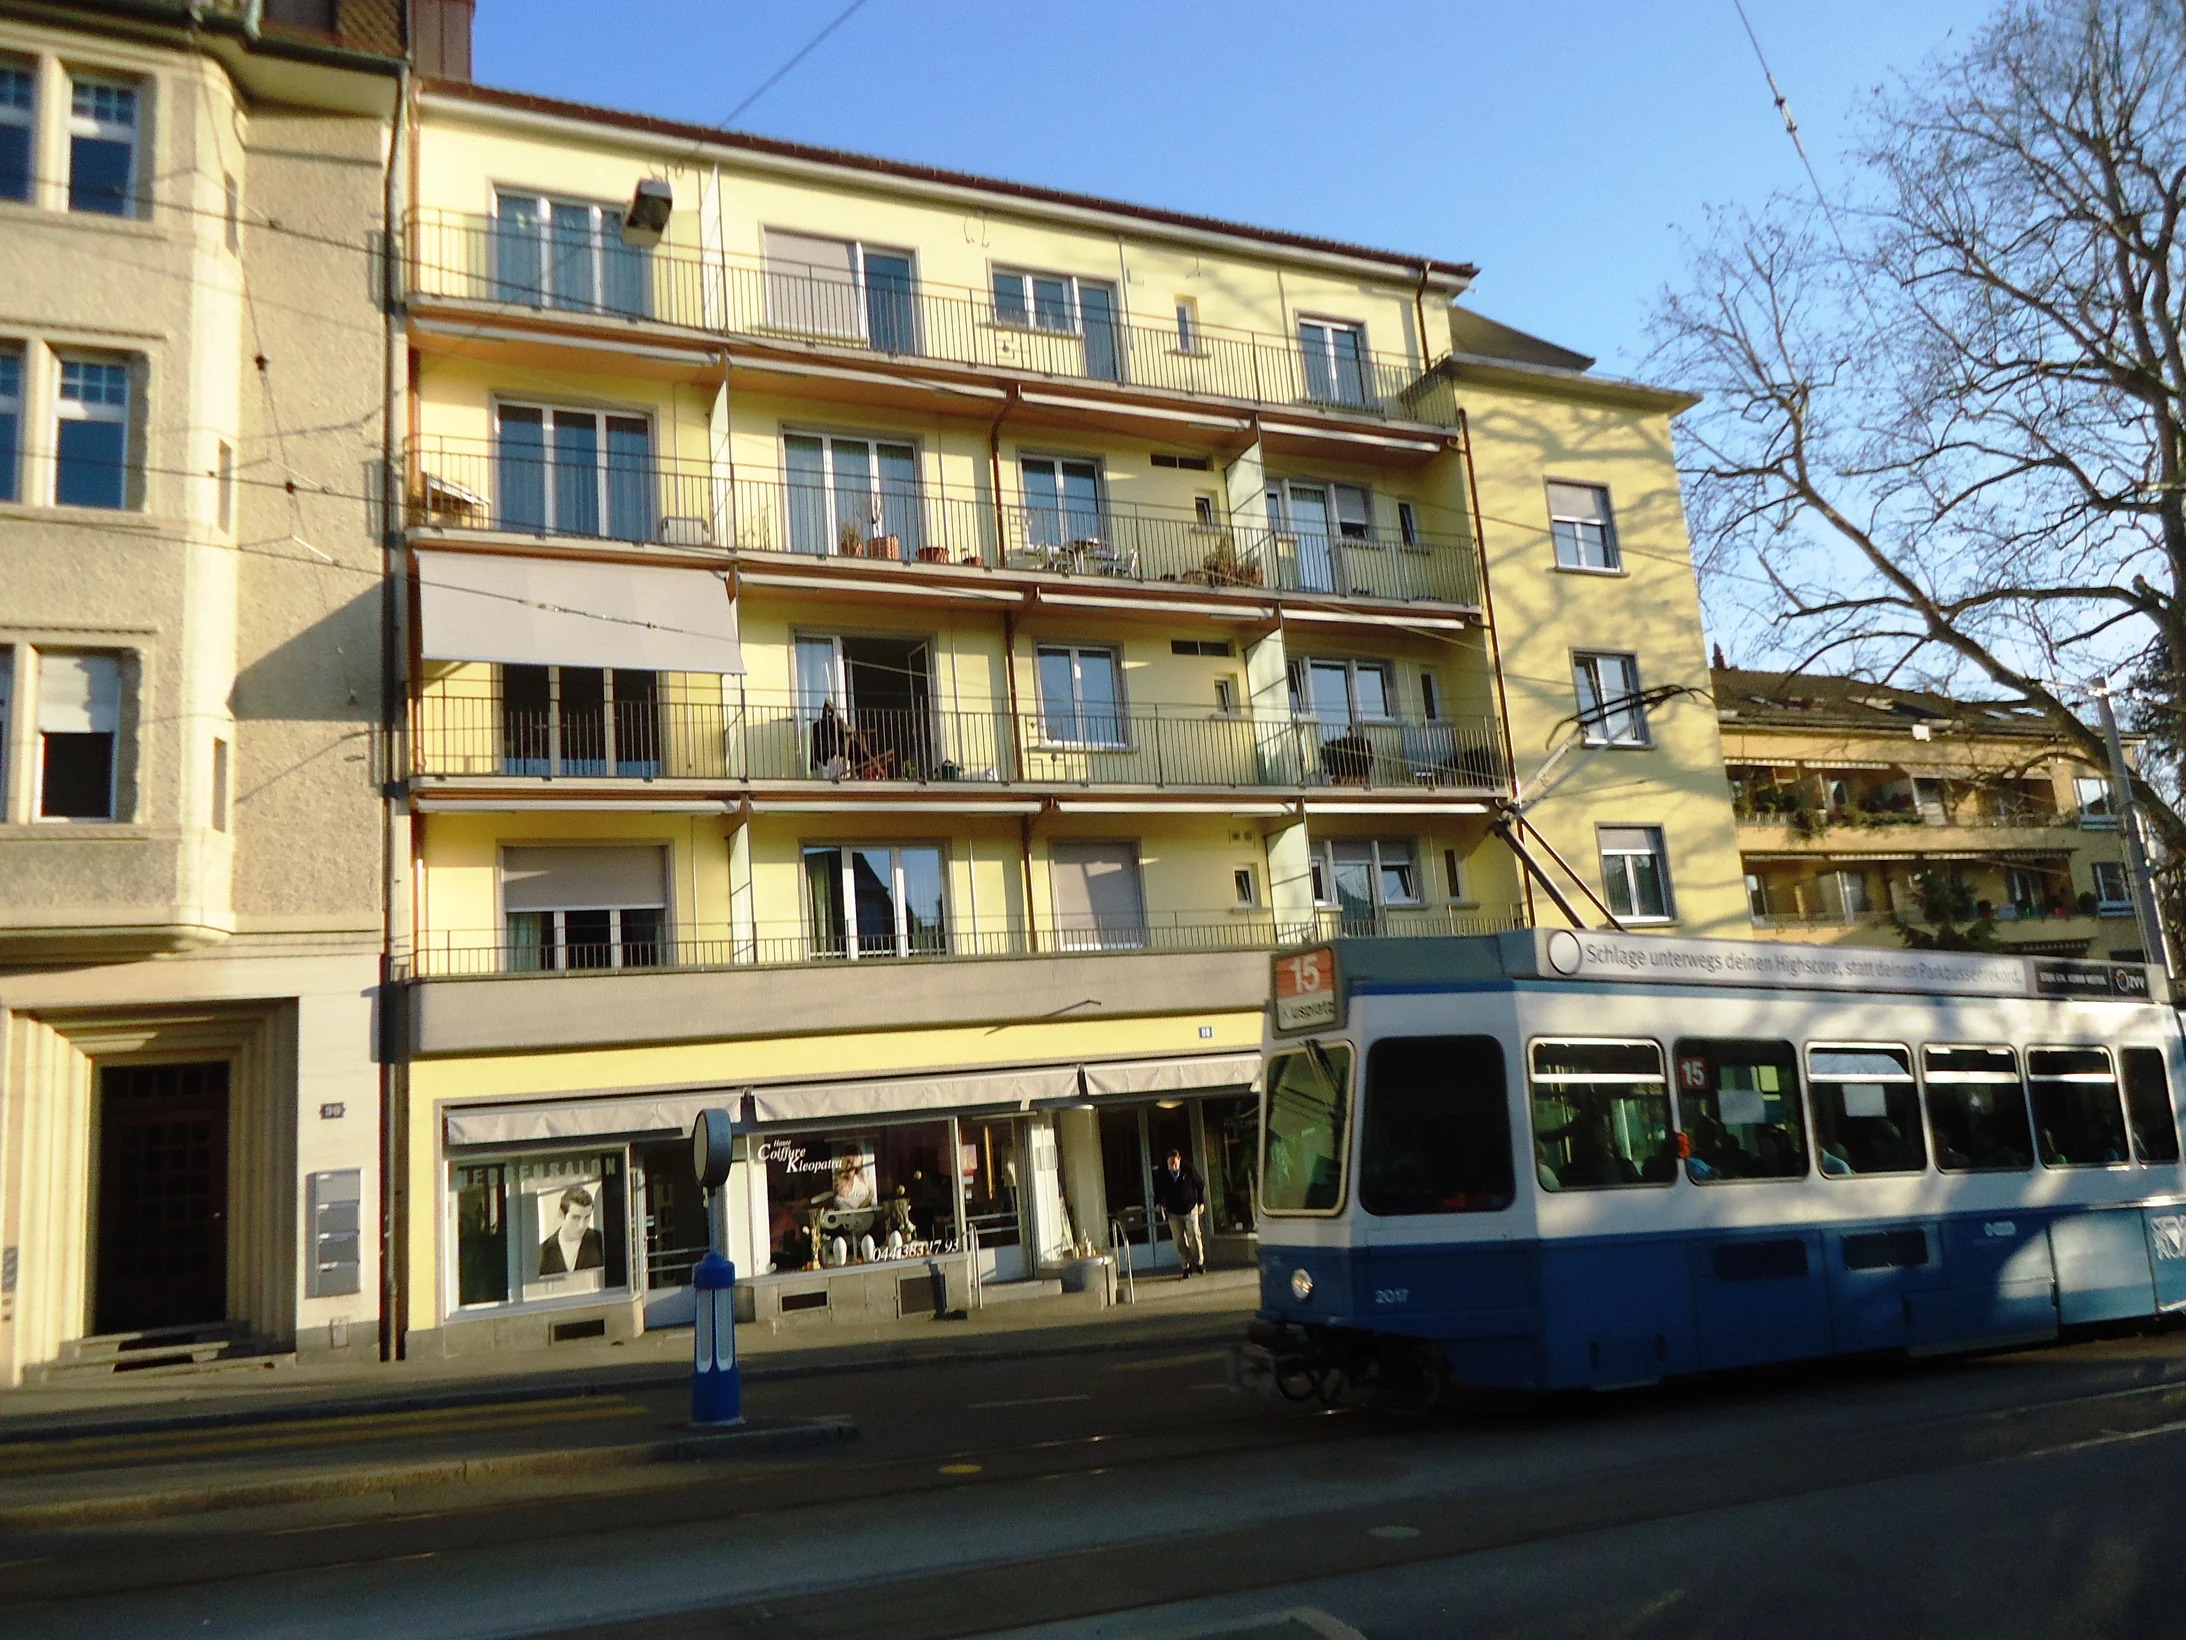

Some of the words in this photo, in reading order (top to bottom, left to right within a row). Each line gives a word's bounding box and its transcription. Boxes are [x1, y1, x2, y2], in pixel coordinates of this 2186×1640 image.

[1585, 943, 1646, 969] Schlage
[1650, 949, 1721, 973] unterwegs
[1725, 951, 1773, 972] deinen
[1289, 953, 1320, 993] 15
[1681, 1060, 1704, 1086] 15
[786, 1157, 842, 1173] Kleopatra
[873, 1245, 897, 1263] 044
[944, 1238, 959, 1254] 93
